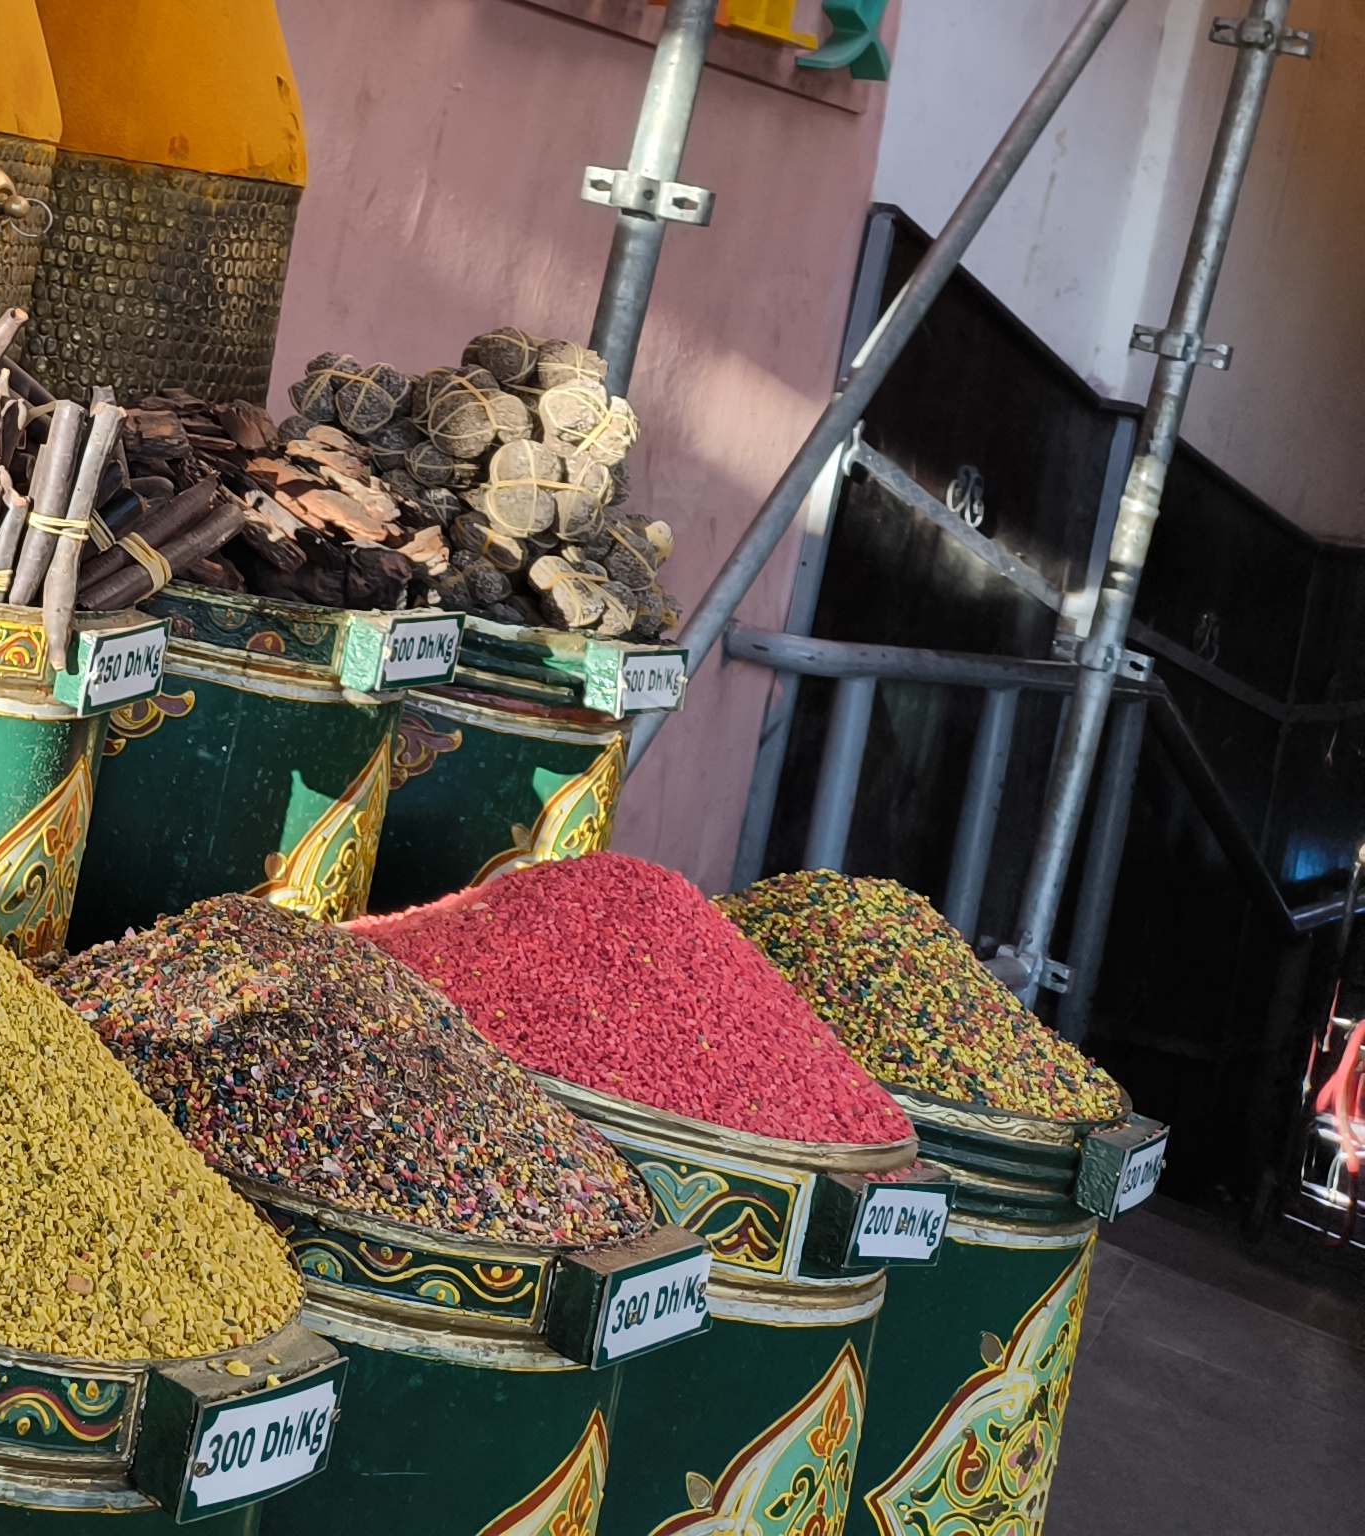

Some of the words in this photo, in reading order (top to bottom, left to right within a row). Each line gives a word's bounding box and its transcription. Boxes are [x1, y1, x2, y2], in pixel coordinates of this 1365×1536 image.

[124, 644, 163, 679] Dh/Kg
[389, 636, 415, 663] 500
[416, 633, 456, 664] Dh/Kg
[647, 667, 682, 696] Dh/Kg
[863, 1205, 894, 1236] 200
[894, 1205, 944, 1247] Dh/Kg
[611, 1291, 650, 1335] 300
[653, 1272, 707, 1320] Dh/Kg
[205, 1426, 256, 1476] 300
[260, 1405, 331, 1463] Dh/Kg
